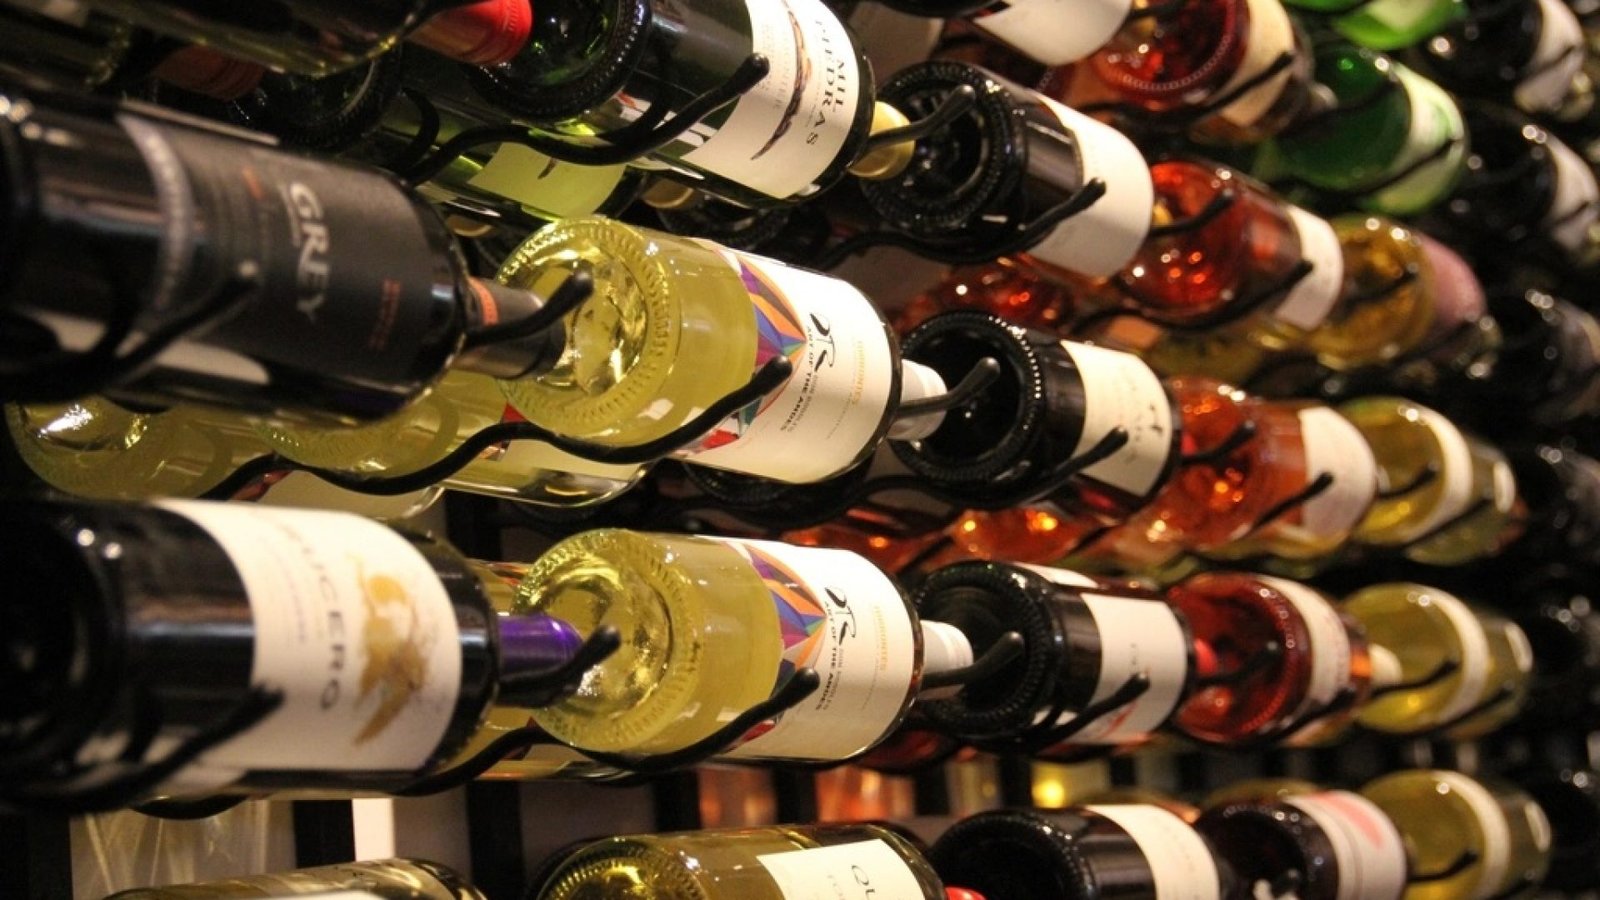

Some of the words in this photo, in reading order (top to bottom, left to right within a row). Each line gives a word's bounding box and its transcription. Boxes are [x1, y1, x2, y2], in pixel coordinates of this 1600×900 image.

[832, 60, 847, 112] MIL
[290, 182, 331, 326] GREY
[801, 372, 812, 395] THE
[780, 396, 804, 432] ANDES
[264, 516, 345, 711] UCERO
[830, 647, 838, 670] THE
[815, 672, 834, 712] ANDES
